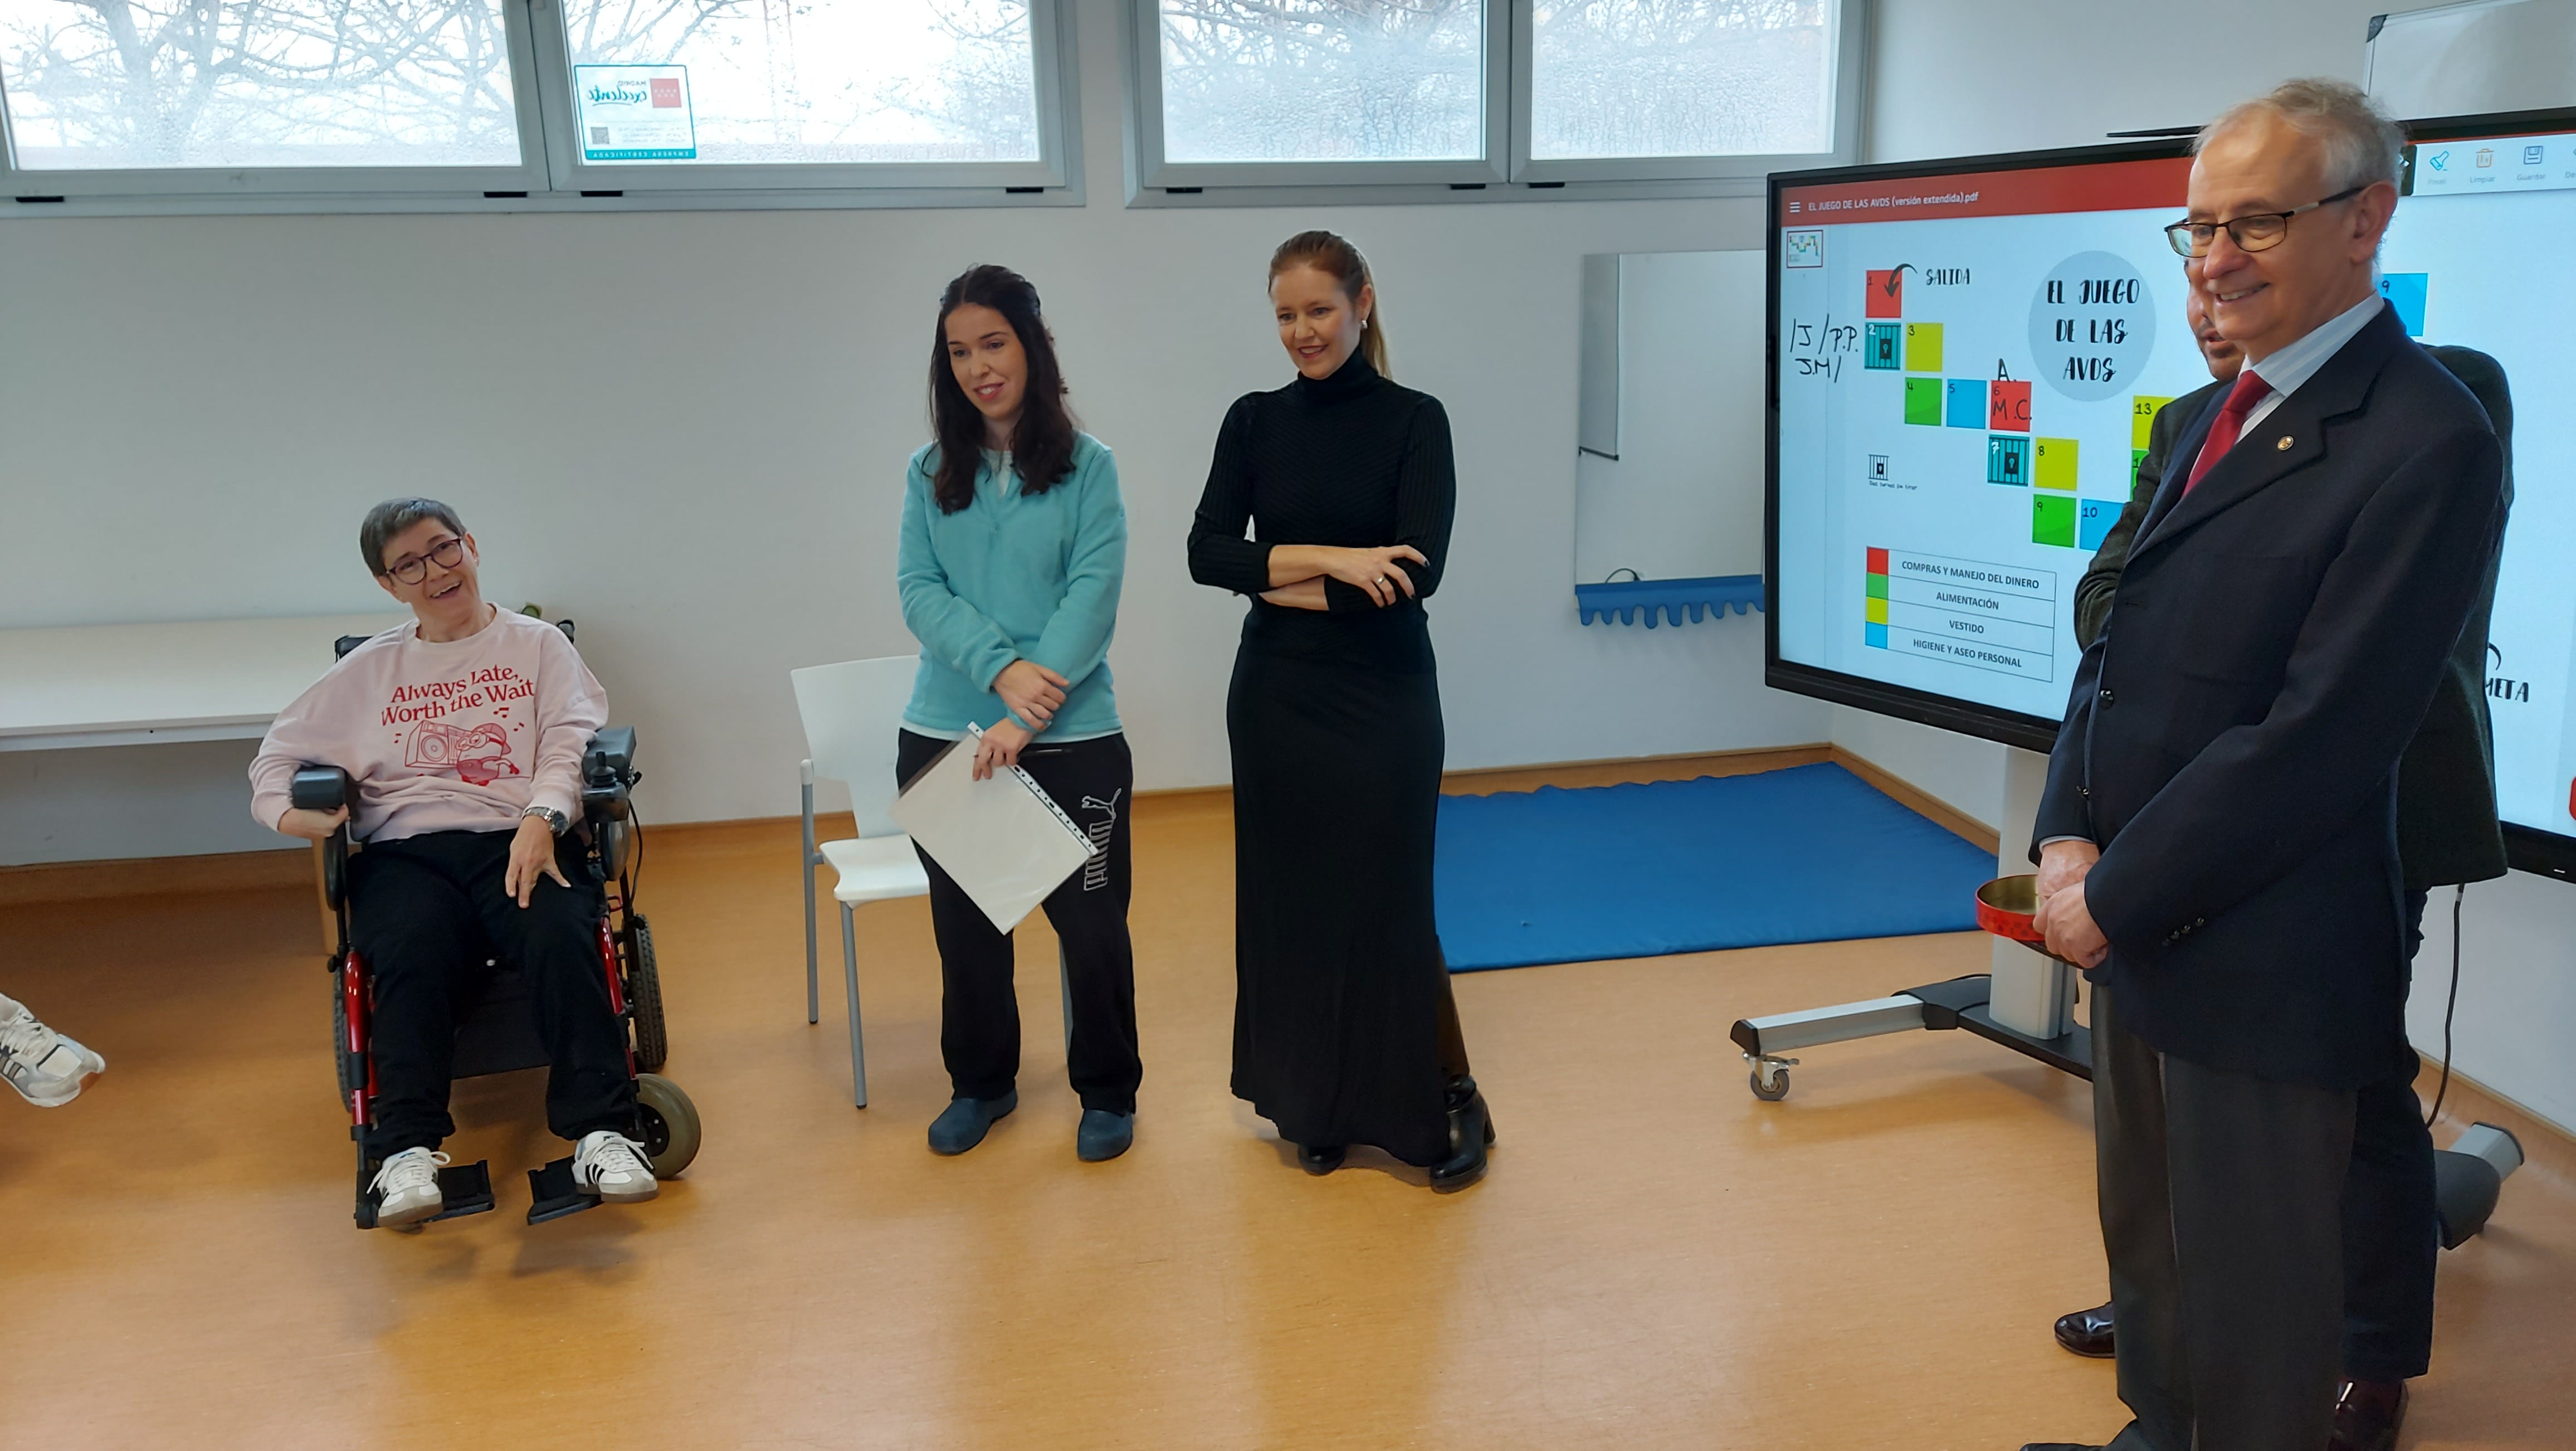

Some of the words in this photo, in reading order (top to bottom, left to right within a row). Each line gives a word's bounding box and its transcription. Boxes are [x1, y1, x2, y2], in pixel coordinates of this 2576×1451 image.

[1808, 202, 1817, 211] EL
[1818, 201, 1841, 211] JUEGO
[1843, 200, 1852, 209] DE
[1854, 199, 1868, 208] LAS
[1870, 197, 1890, 207] AVDS
[1892, 195, 1921, 207] (versión
[1923, 191, 1979, 203] extendida).pdf
[1867, 276, 1873, 285] 1
[1926, 268, 1970, 285] SALIDA
[2047, 280, 2065, 304] EL
[2079, 279, 2139, 304] JUEGO
[1868, 324, 1876, 335] 2
[1907, 325, 1915, 336] 3
[2056, 319, 2075, 342] DE
[2090, 319, 2128, 344] LAS
[2063, 357, 2116, 382] AVDS
[1907, 382, 1914, 391] 4
[1949, 383, 1955, 393] 5
[1994, 386, 2000, 396] 6
[2134, 403, 2151, 415] 13
[1991, 441, 1999, 455] 7
[2038, 446, 2045, 456] 8
[2133, 457, 2139, 468] 1
[2037, 501, 2043, 512] 9
[2082, 507, 2097, 518] 10
[1902, 561, 1941, 574] COMPRAS
[1950, 568, 1985, 581] MANEJO
[1988, 573, 2003, 584] DEL
[2006, 576, 2040, 588] DINERO
[1936, 592, 1999, 610] ALIMENTACIÓN
[1949, 620, 1984, 634] VESTIDO
[1913, 639, 1945, 653] HIGIENE
[1954, 647, 1975, 658] ASEO
[1978, 651, 2022, 668] PERSONAL
[391, 679, 467, 703] Always
[471, 665, 518, 685] Late,
[381, 702, 445, 726] Worth
[450, 695, 483, 712] the
[484, 679, 535, 703] Wait
